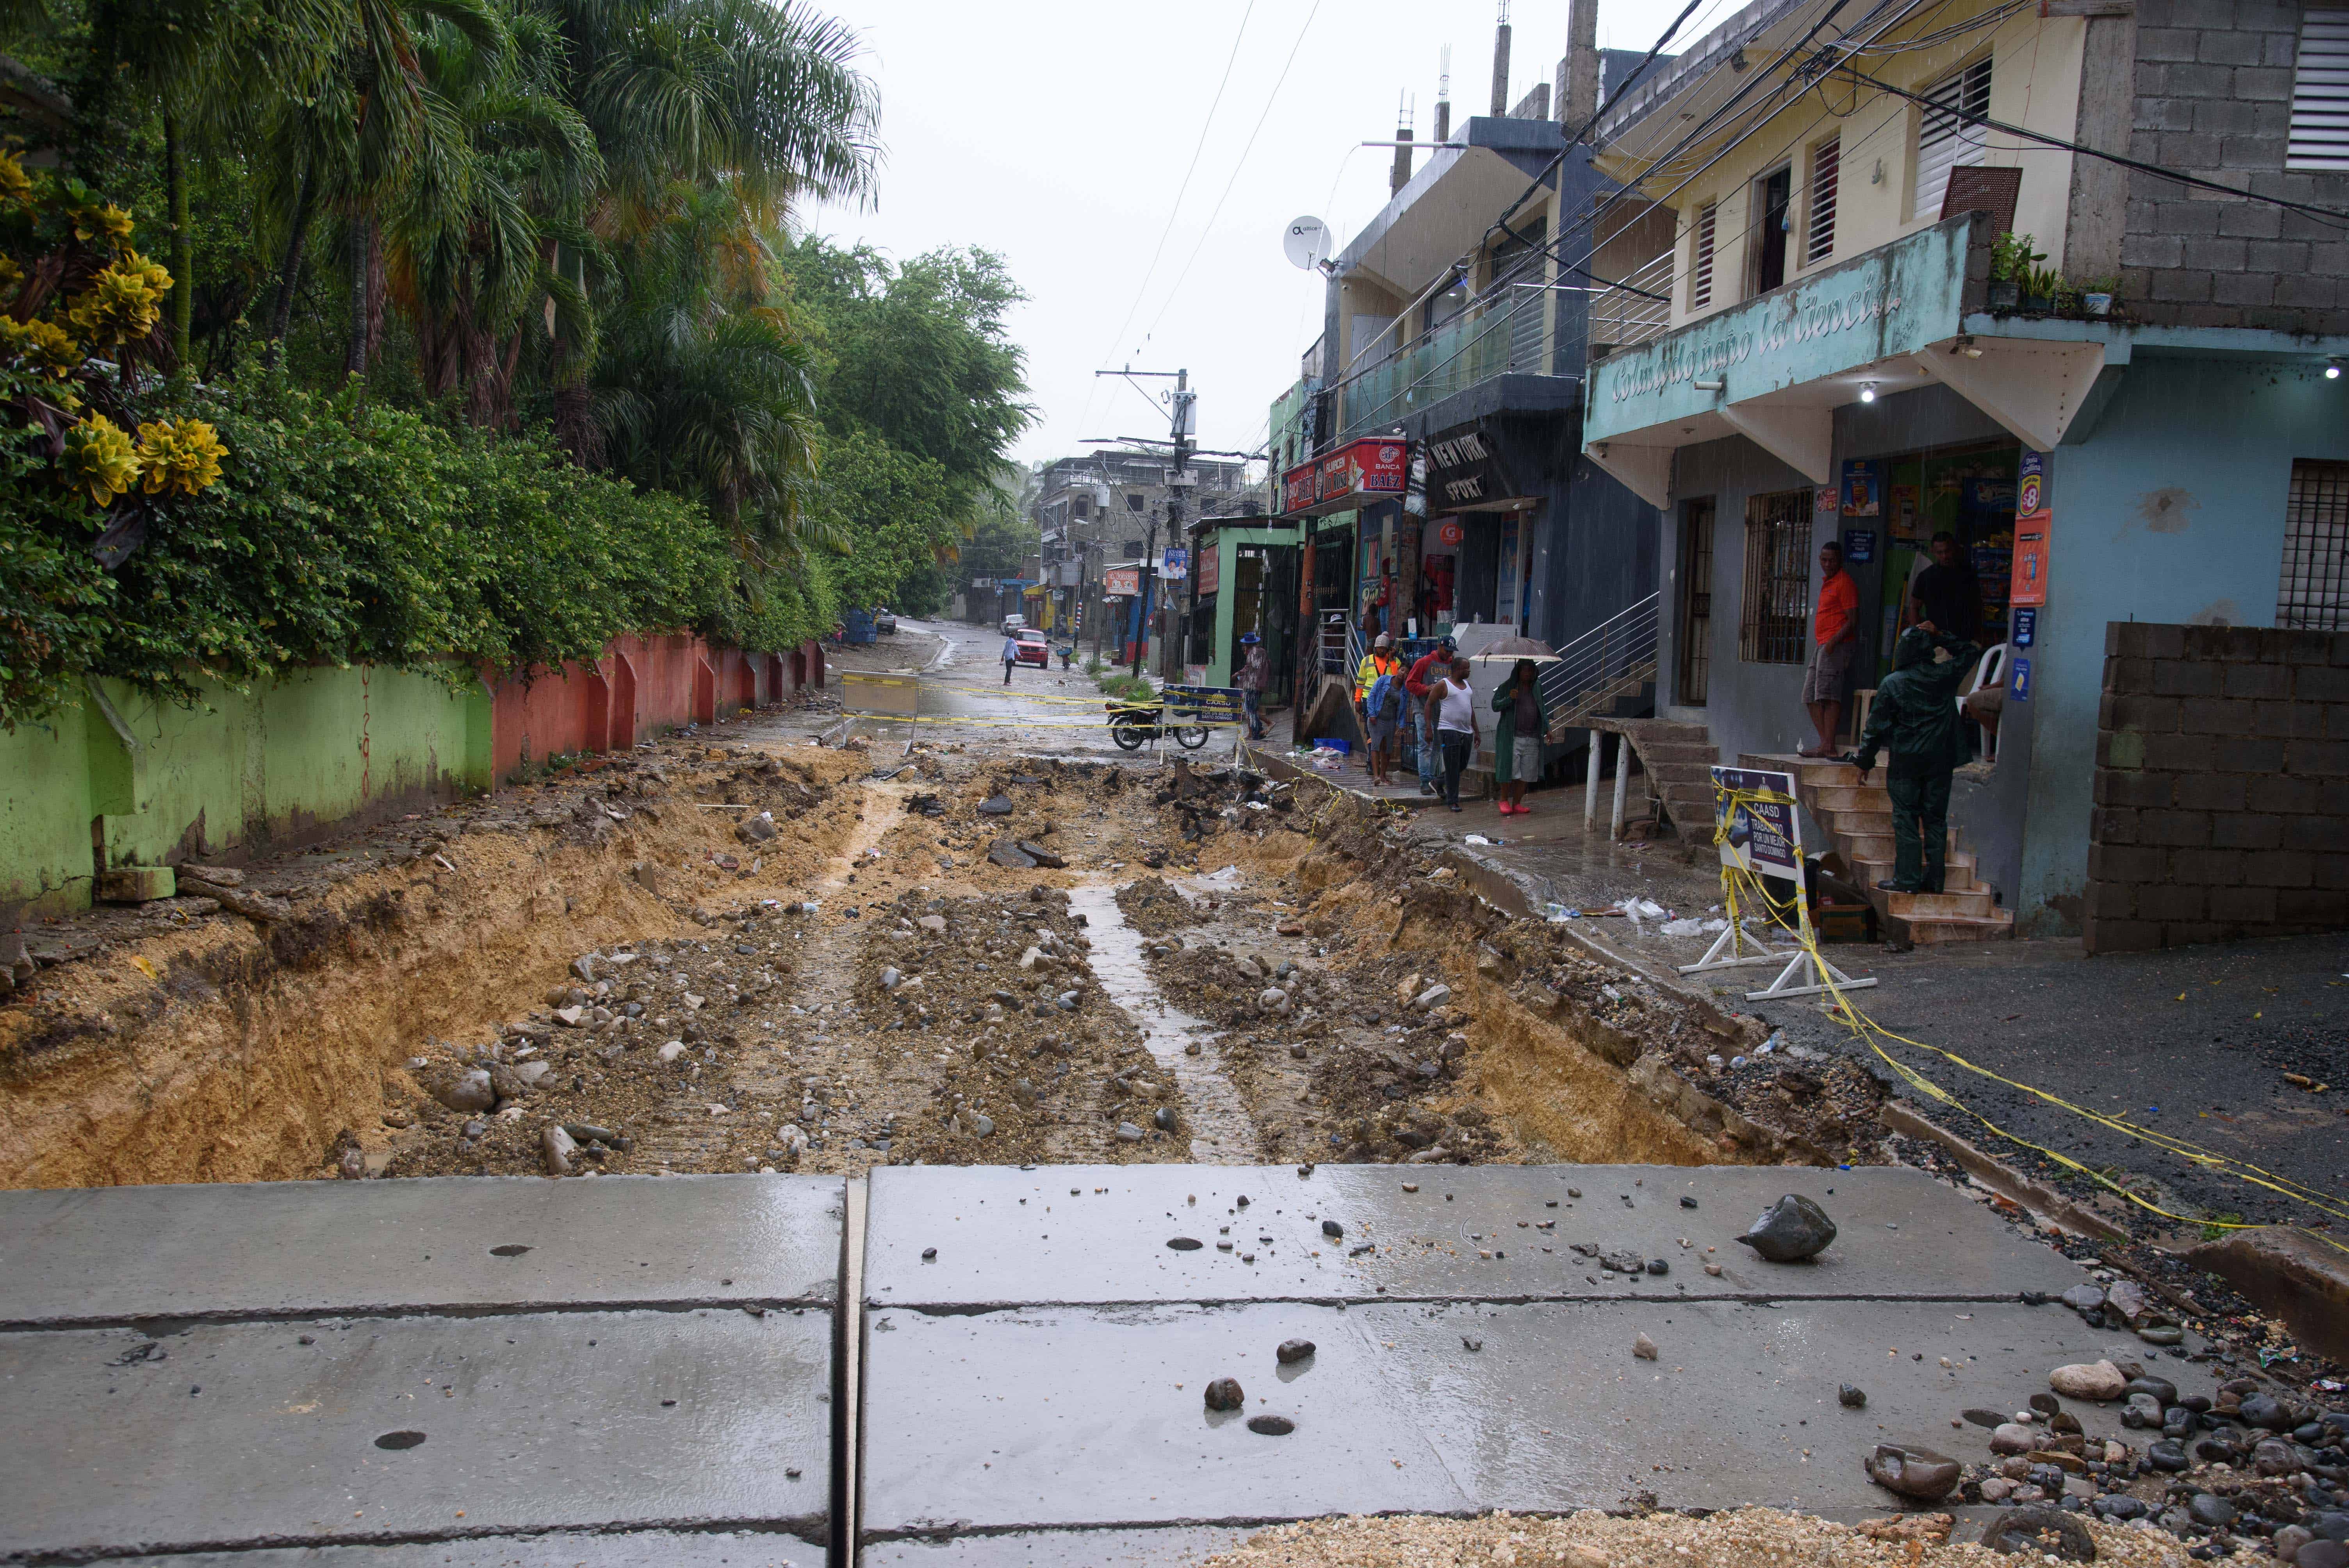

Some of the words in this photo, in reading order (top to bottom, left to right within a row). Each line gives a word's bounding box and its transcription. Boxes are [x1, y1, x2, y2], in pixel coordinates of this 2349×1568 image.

[1613, 341, 1698, 403] Colmado
[1794, 271, 1901, 344] Ciencia
[1431, 441, 1461, 469] NEW
[1452, 433, 1488, 462] YORK
[1326, 456, 1345, 473] ALMACEN
[2023, 465, 2041, 475] Gallina
[1445, 477, 1483, 501] SPORT
[2023, 488, 2037, 507] $8
[1754, 803, 1780, 818] CAASD
[1753, 831, 1763, 843] POR
[1763, 833, 1770, 844] UN
[1770, 835, 1786, 848] MEJOR
[1754, 843, 1767, 854] SANTO
[1768, 846, 1786, 858] DOMINGO
